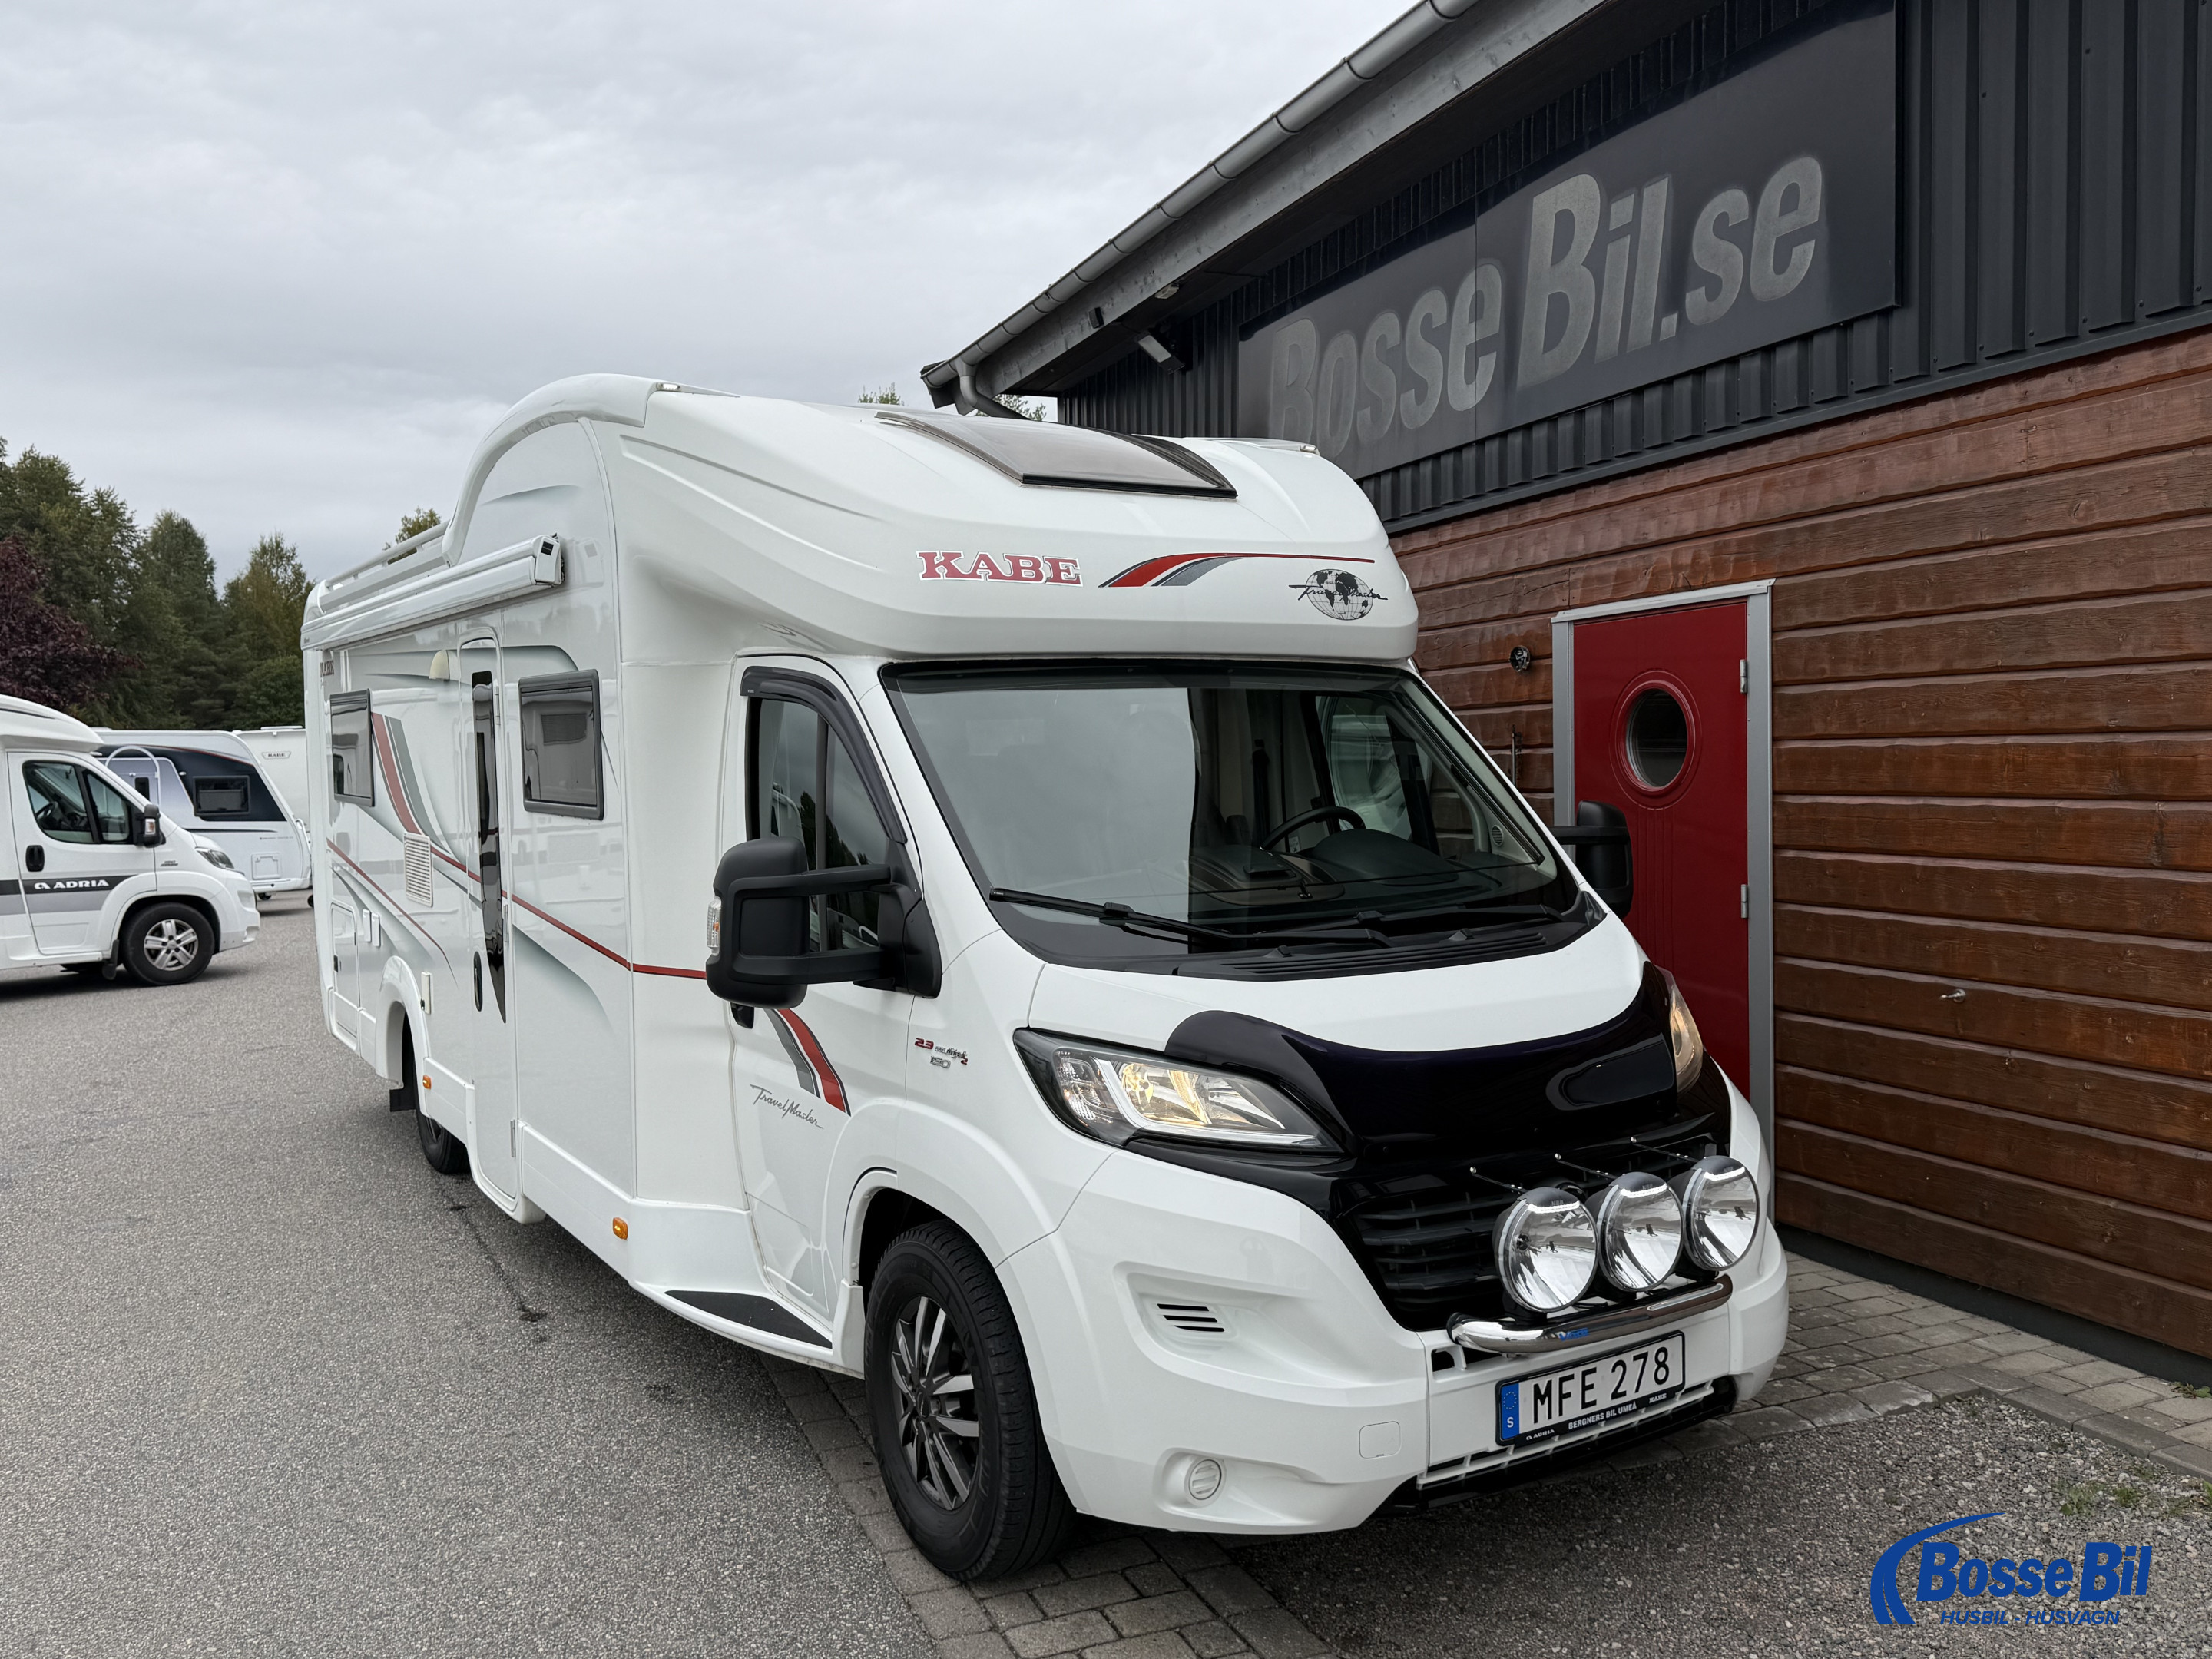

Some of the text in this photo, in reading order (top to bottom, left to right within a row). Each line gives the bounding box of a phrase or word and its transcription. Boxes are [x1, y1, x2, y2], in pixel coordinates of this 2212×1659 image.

[1269, 156, 1823, 460] Bosse Bil.se
[916, 551, 1084, 588] KABE
[53, 879, 109, 889] ADRIA
[1533, 1346, 1670, 1424] MFE 278
[1507, 1416, 1514, 1428] S
[1568, 1401, 1637, 1430] BERGNERS BIL UMEÅ
